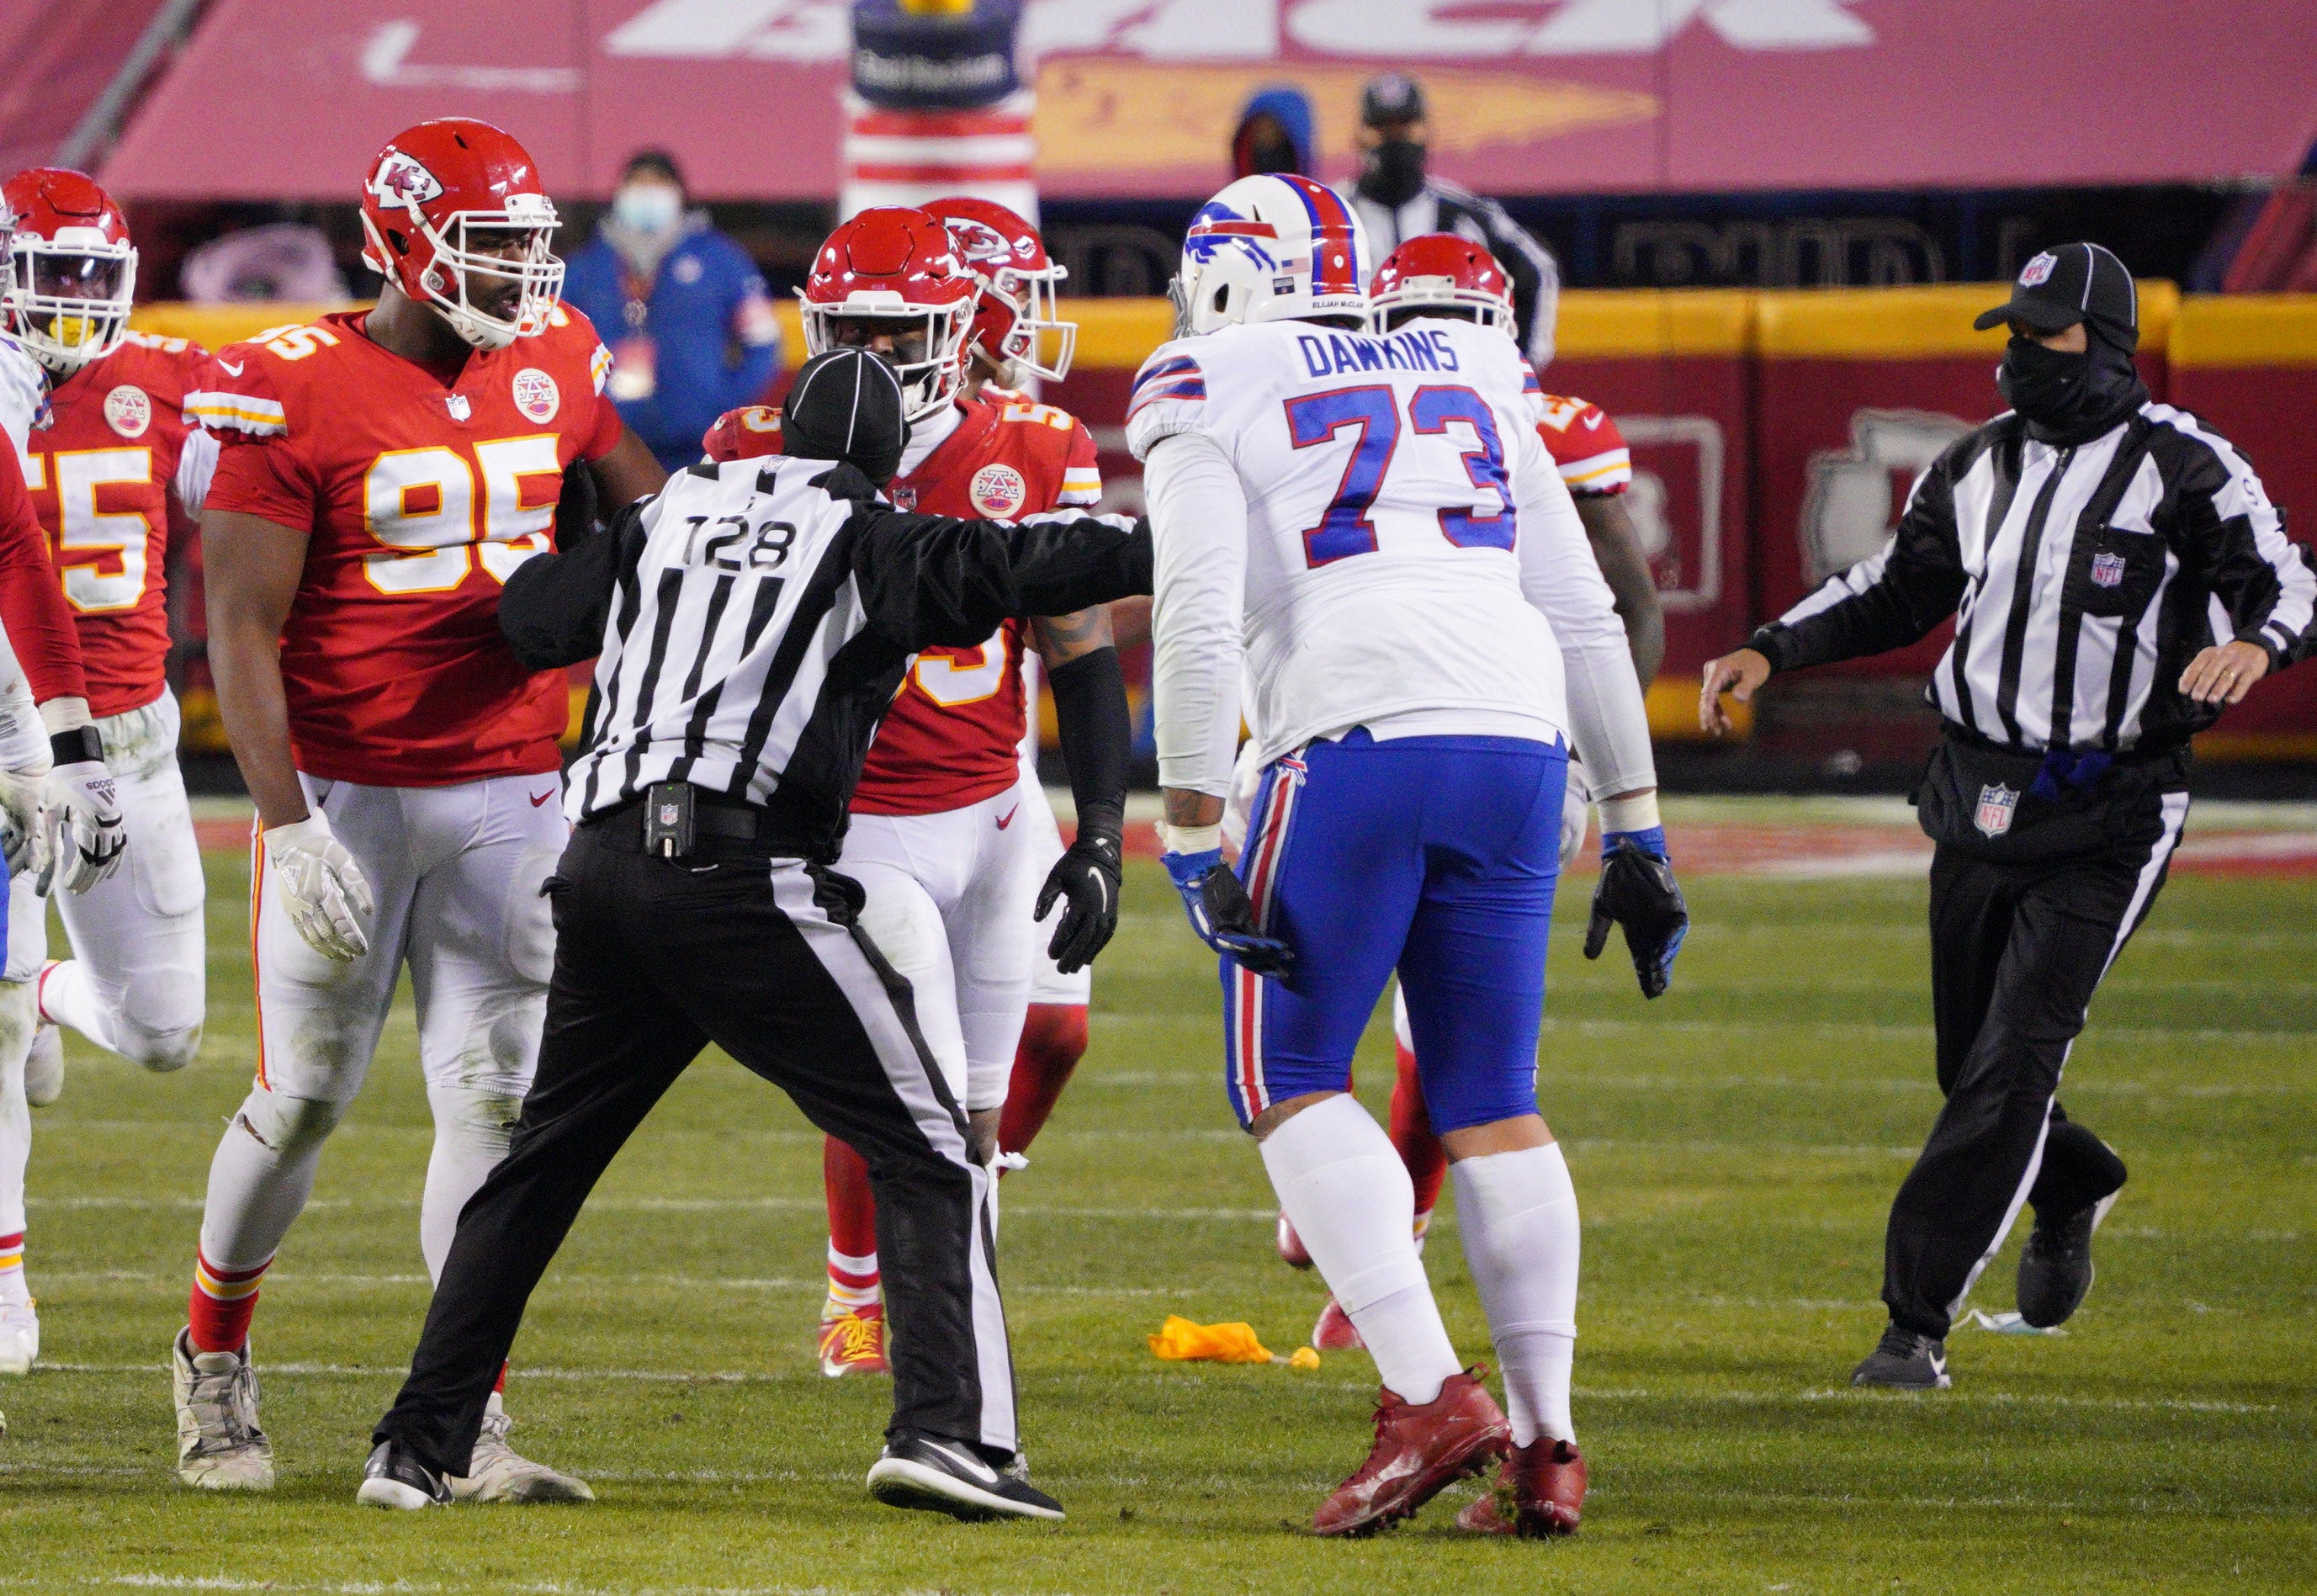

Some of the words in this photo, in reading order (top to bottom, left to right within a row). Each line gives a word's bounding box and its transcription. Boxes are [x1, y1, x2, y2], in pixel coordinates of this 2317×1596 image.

[1312, 300, 1339, 309] ELIJAH
[1296, 330, 1460, 378] DAWKINS
[1282, 383, 1517, 570] 73
[363, 432, 562, 596] 95
[682, 515, 797, 571] 128
